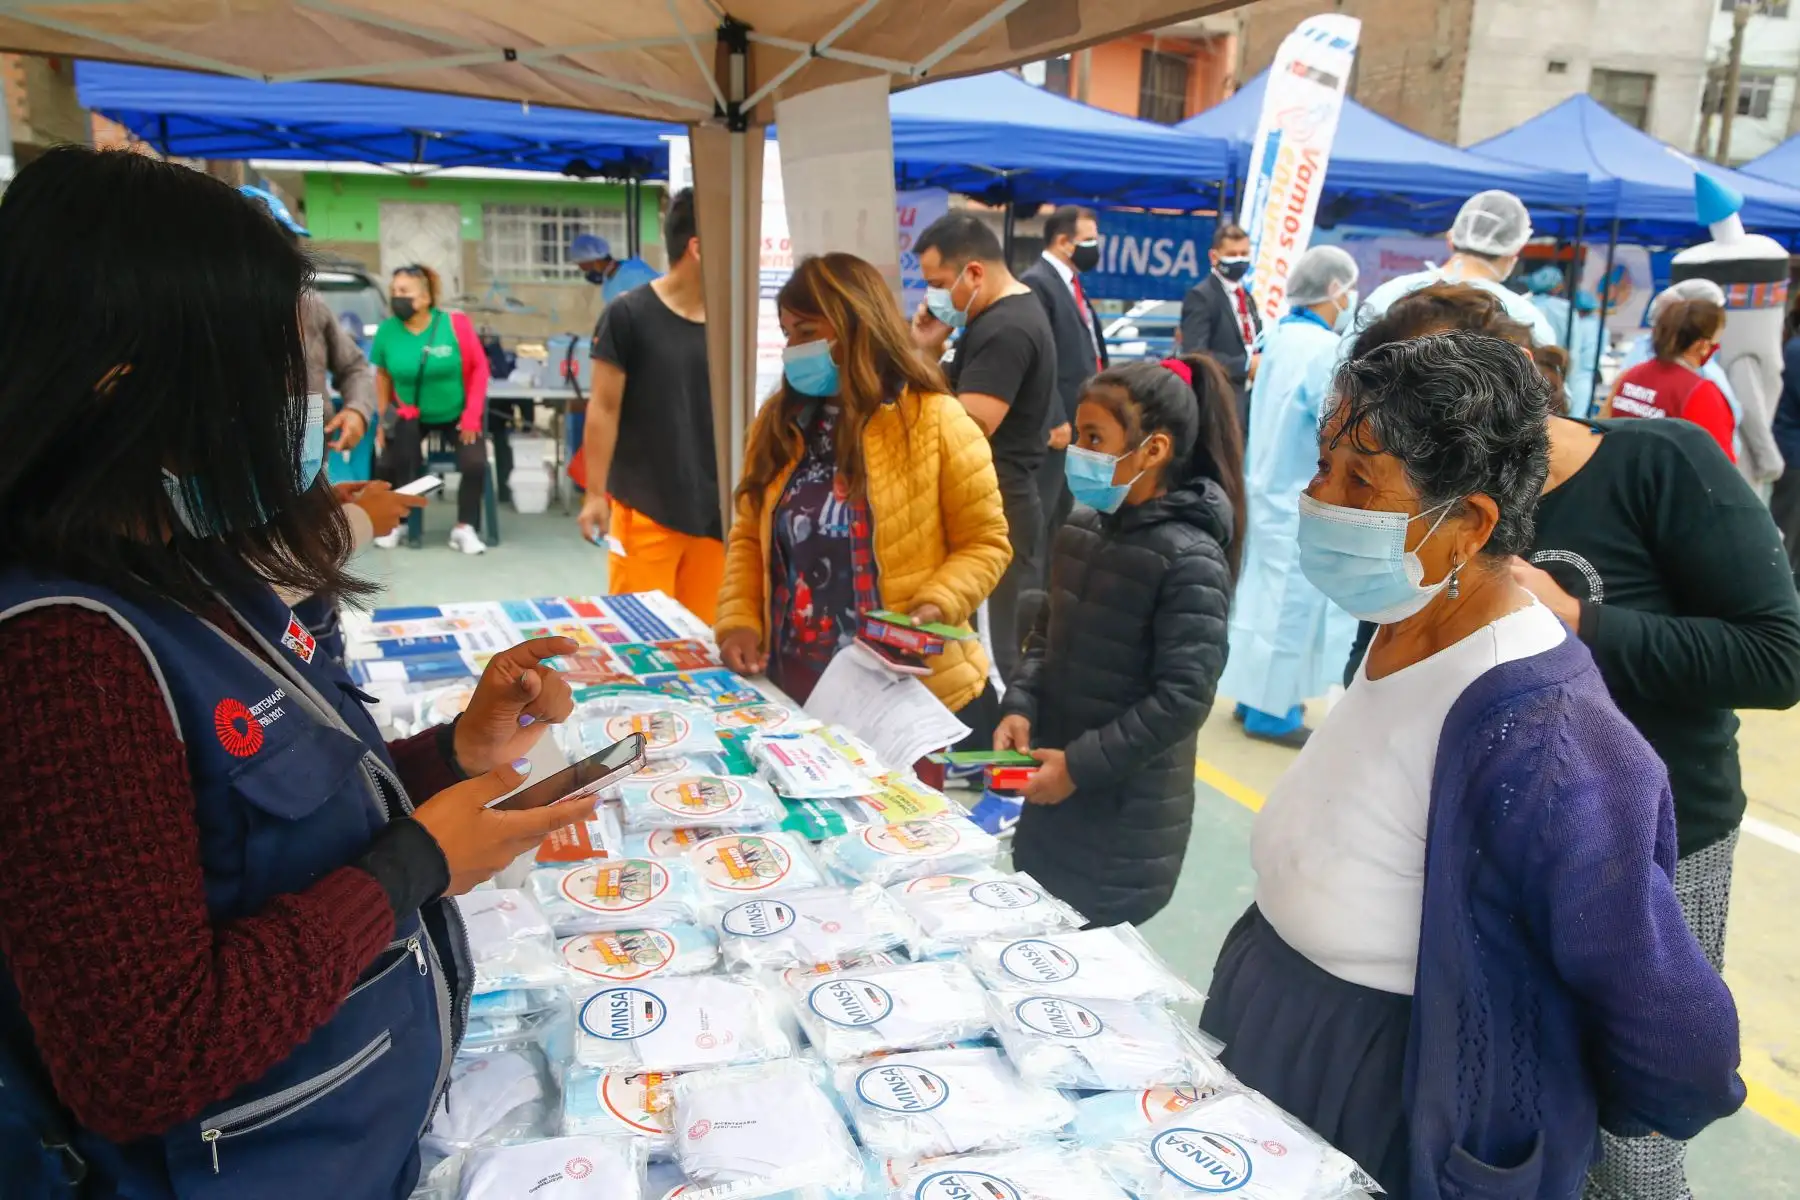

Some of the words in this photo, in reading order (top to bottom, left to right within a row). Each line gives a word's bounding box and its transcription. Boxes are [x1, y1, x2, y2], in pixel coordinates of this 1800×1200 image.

[1280, 148, 1320, 250] Vamos
[745, 902, 767, 935] MINSA
[1018, 943, 1059, 981] MINSA
[611, 992, 629, 1036] MINSA
[829, 982, 869, 1023] MINSA
[1041, 1000, 1073, 1036] MINSA
[880, 1067, 921, 1110] MINSA
[1165, 1135, 1238, 1186] MINSA
[939, 1175, 972, 1200] NSA
